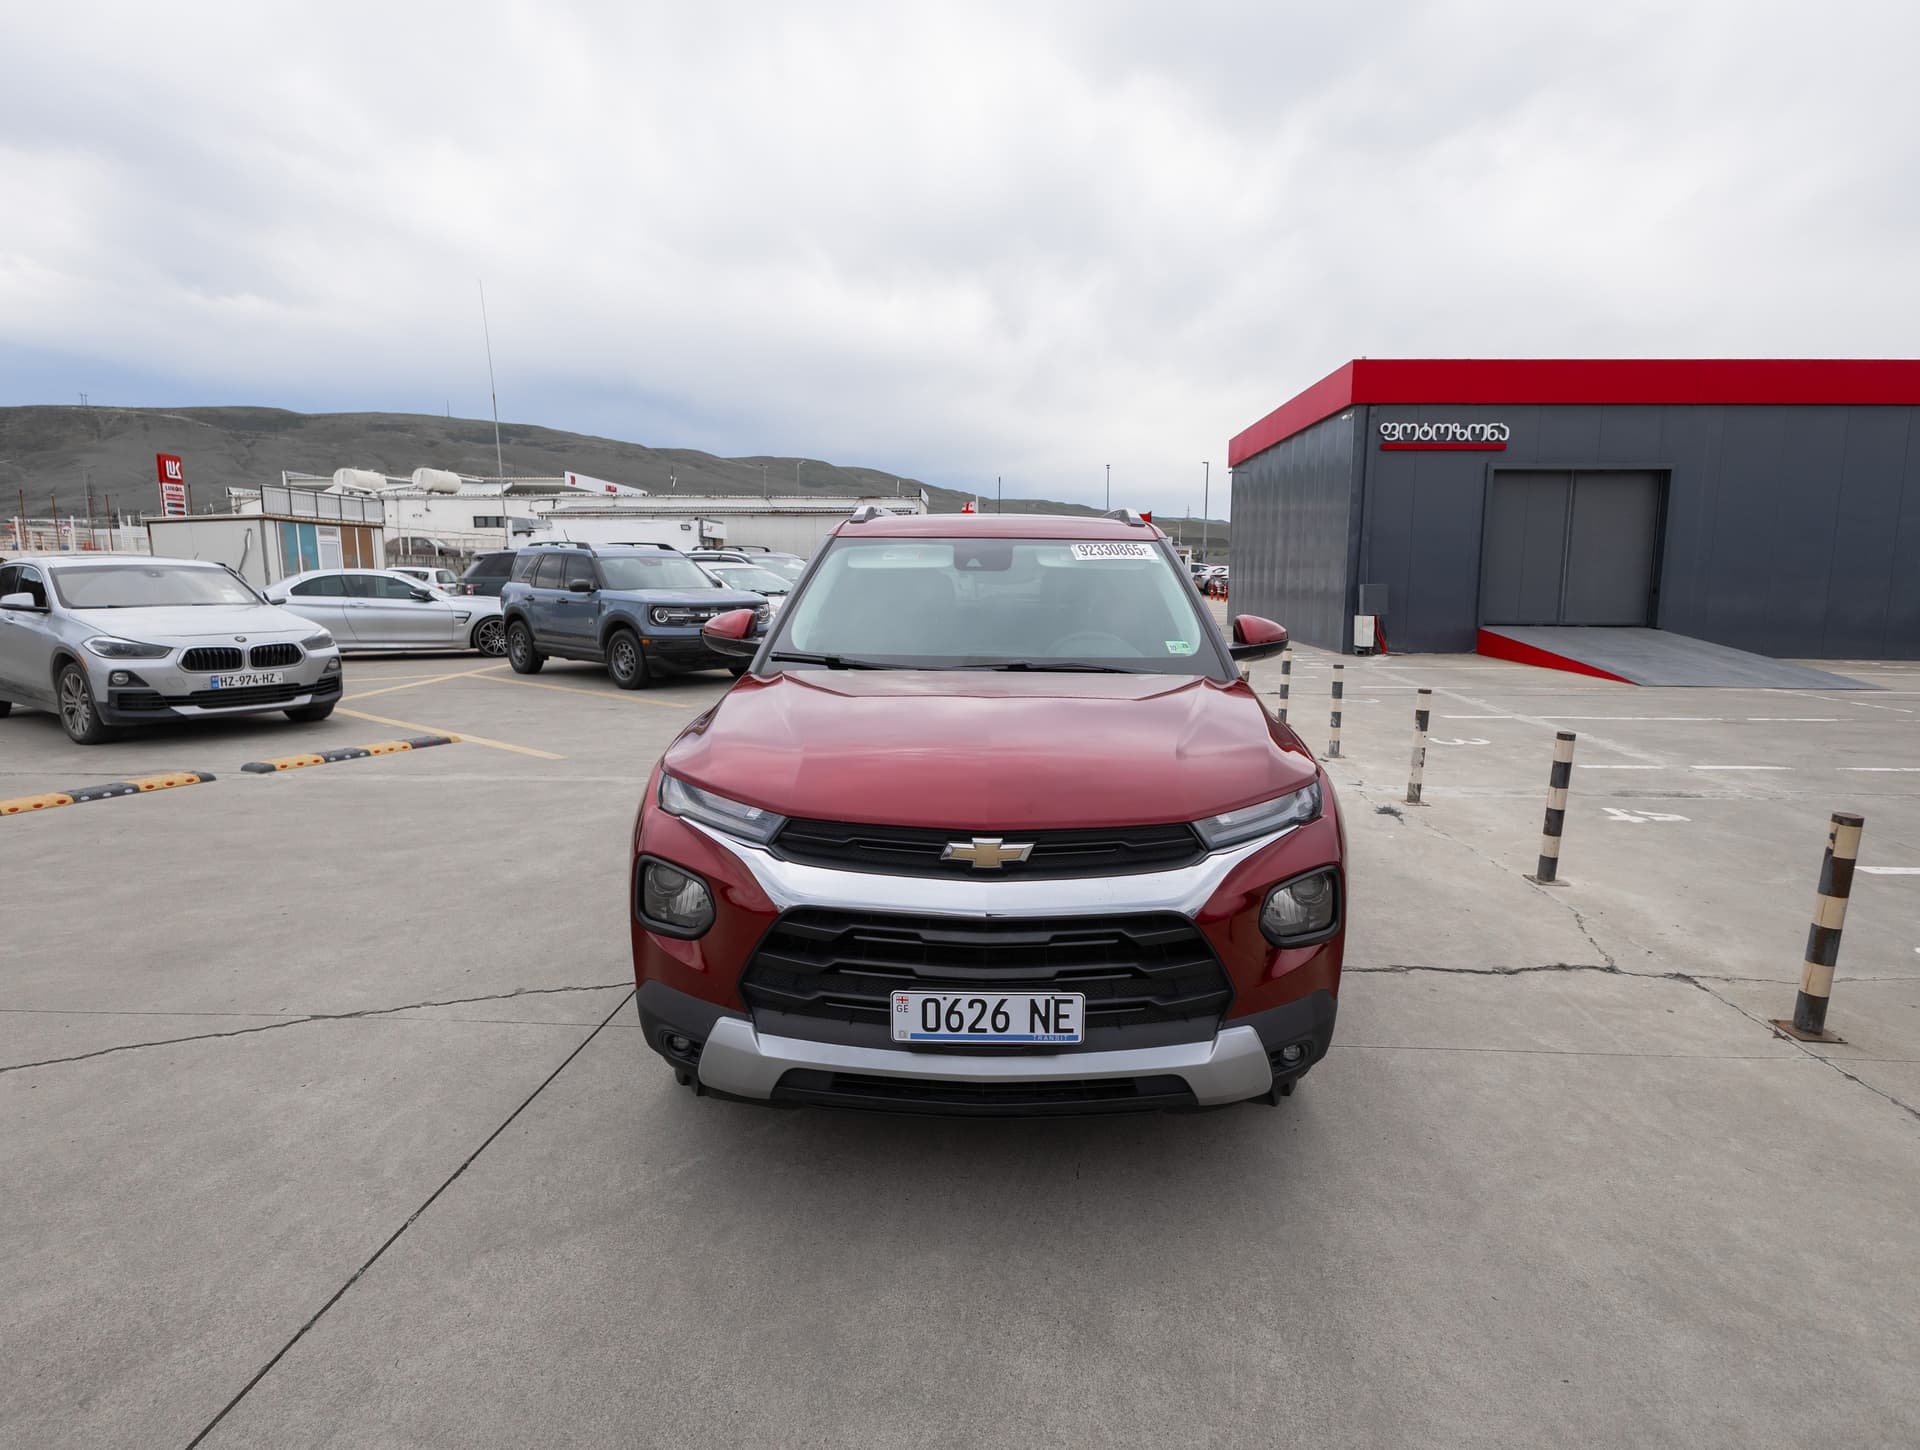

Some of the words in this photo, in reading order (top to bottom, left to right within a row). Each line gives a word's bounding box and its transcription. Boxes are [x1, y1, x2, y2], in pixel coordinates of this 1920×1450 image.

[1380, 422, 1510, 441] ფოტოზონა
[1077, 544, 1144, 556] 92330865
[220, 673, 275, 687] HZ-974-HZ
[896, 1004, 909, 1013] GE
[921, 997, 1010, 1033] 0626
[1029, 998, 1074, 1034] NE
